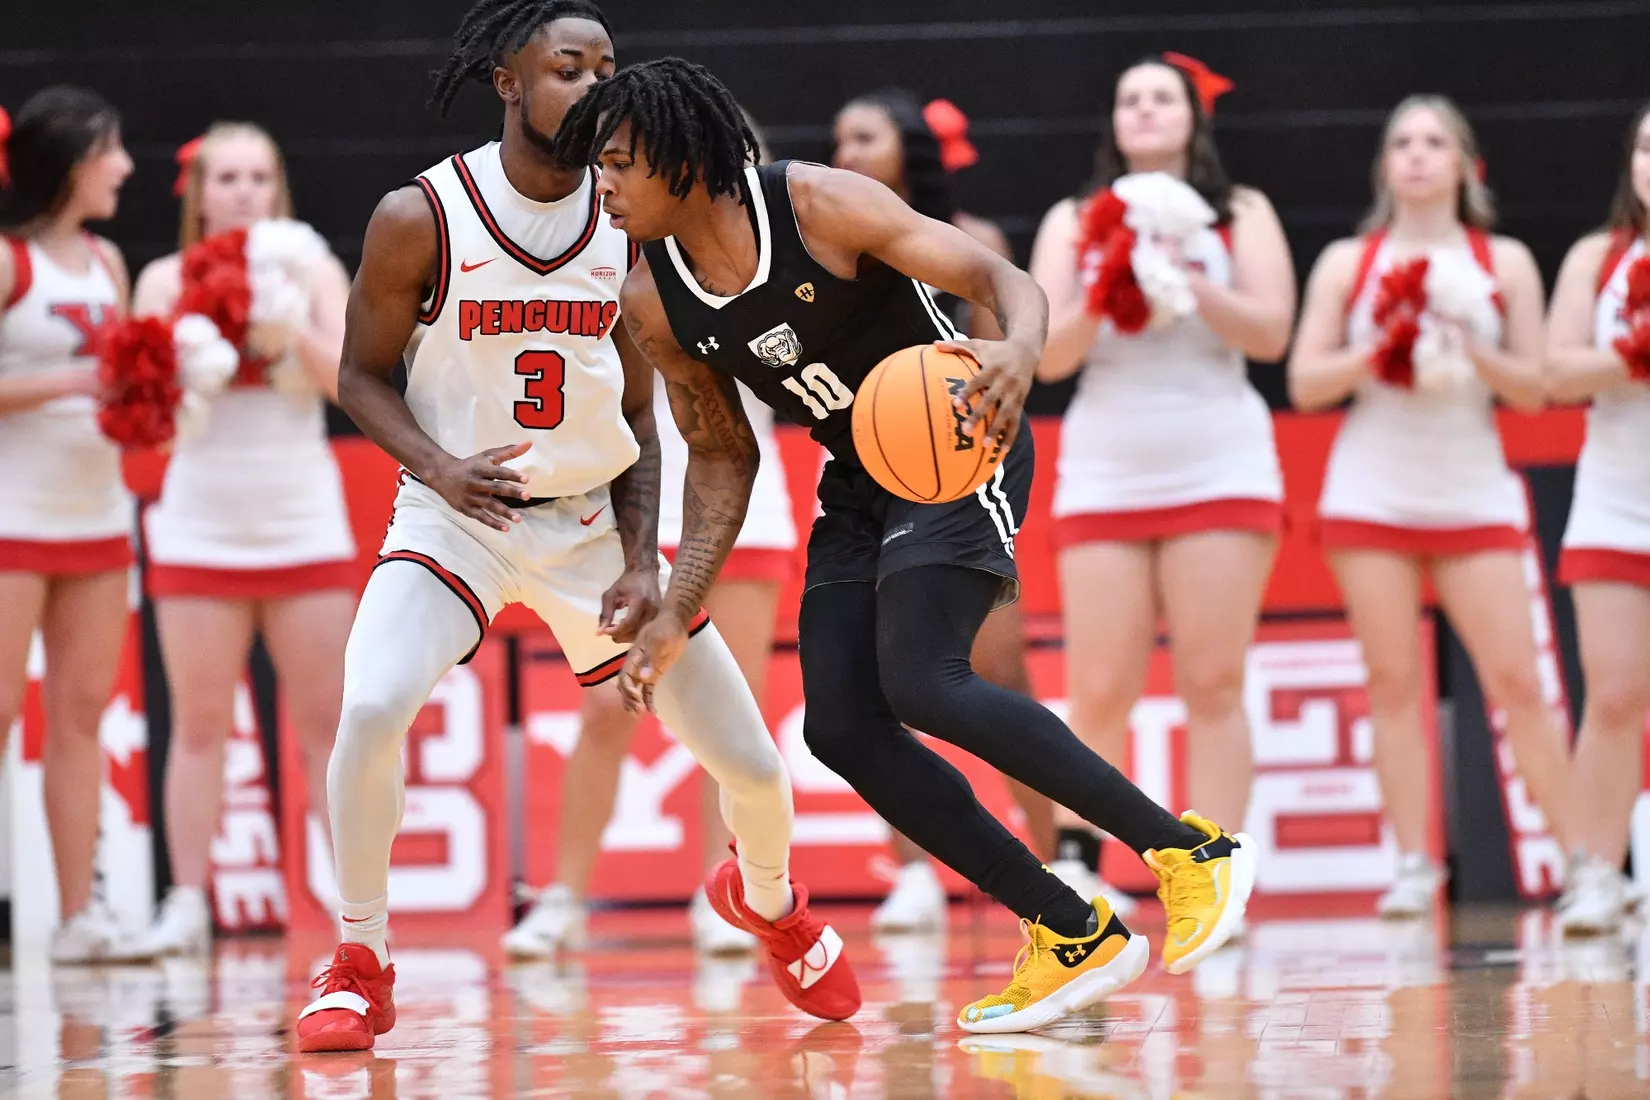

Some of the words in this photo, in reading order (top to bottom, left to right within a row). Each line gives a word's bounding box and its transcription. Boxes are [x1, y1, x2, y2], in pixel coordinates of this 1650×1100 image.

[459, 299, 618, 341] PENGUINS
[513, 349, 566, 430] 3
[781, 362, 855, 420] 10
